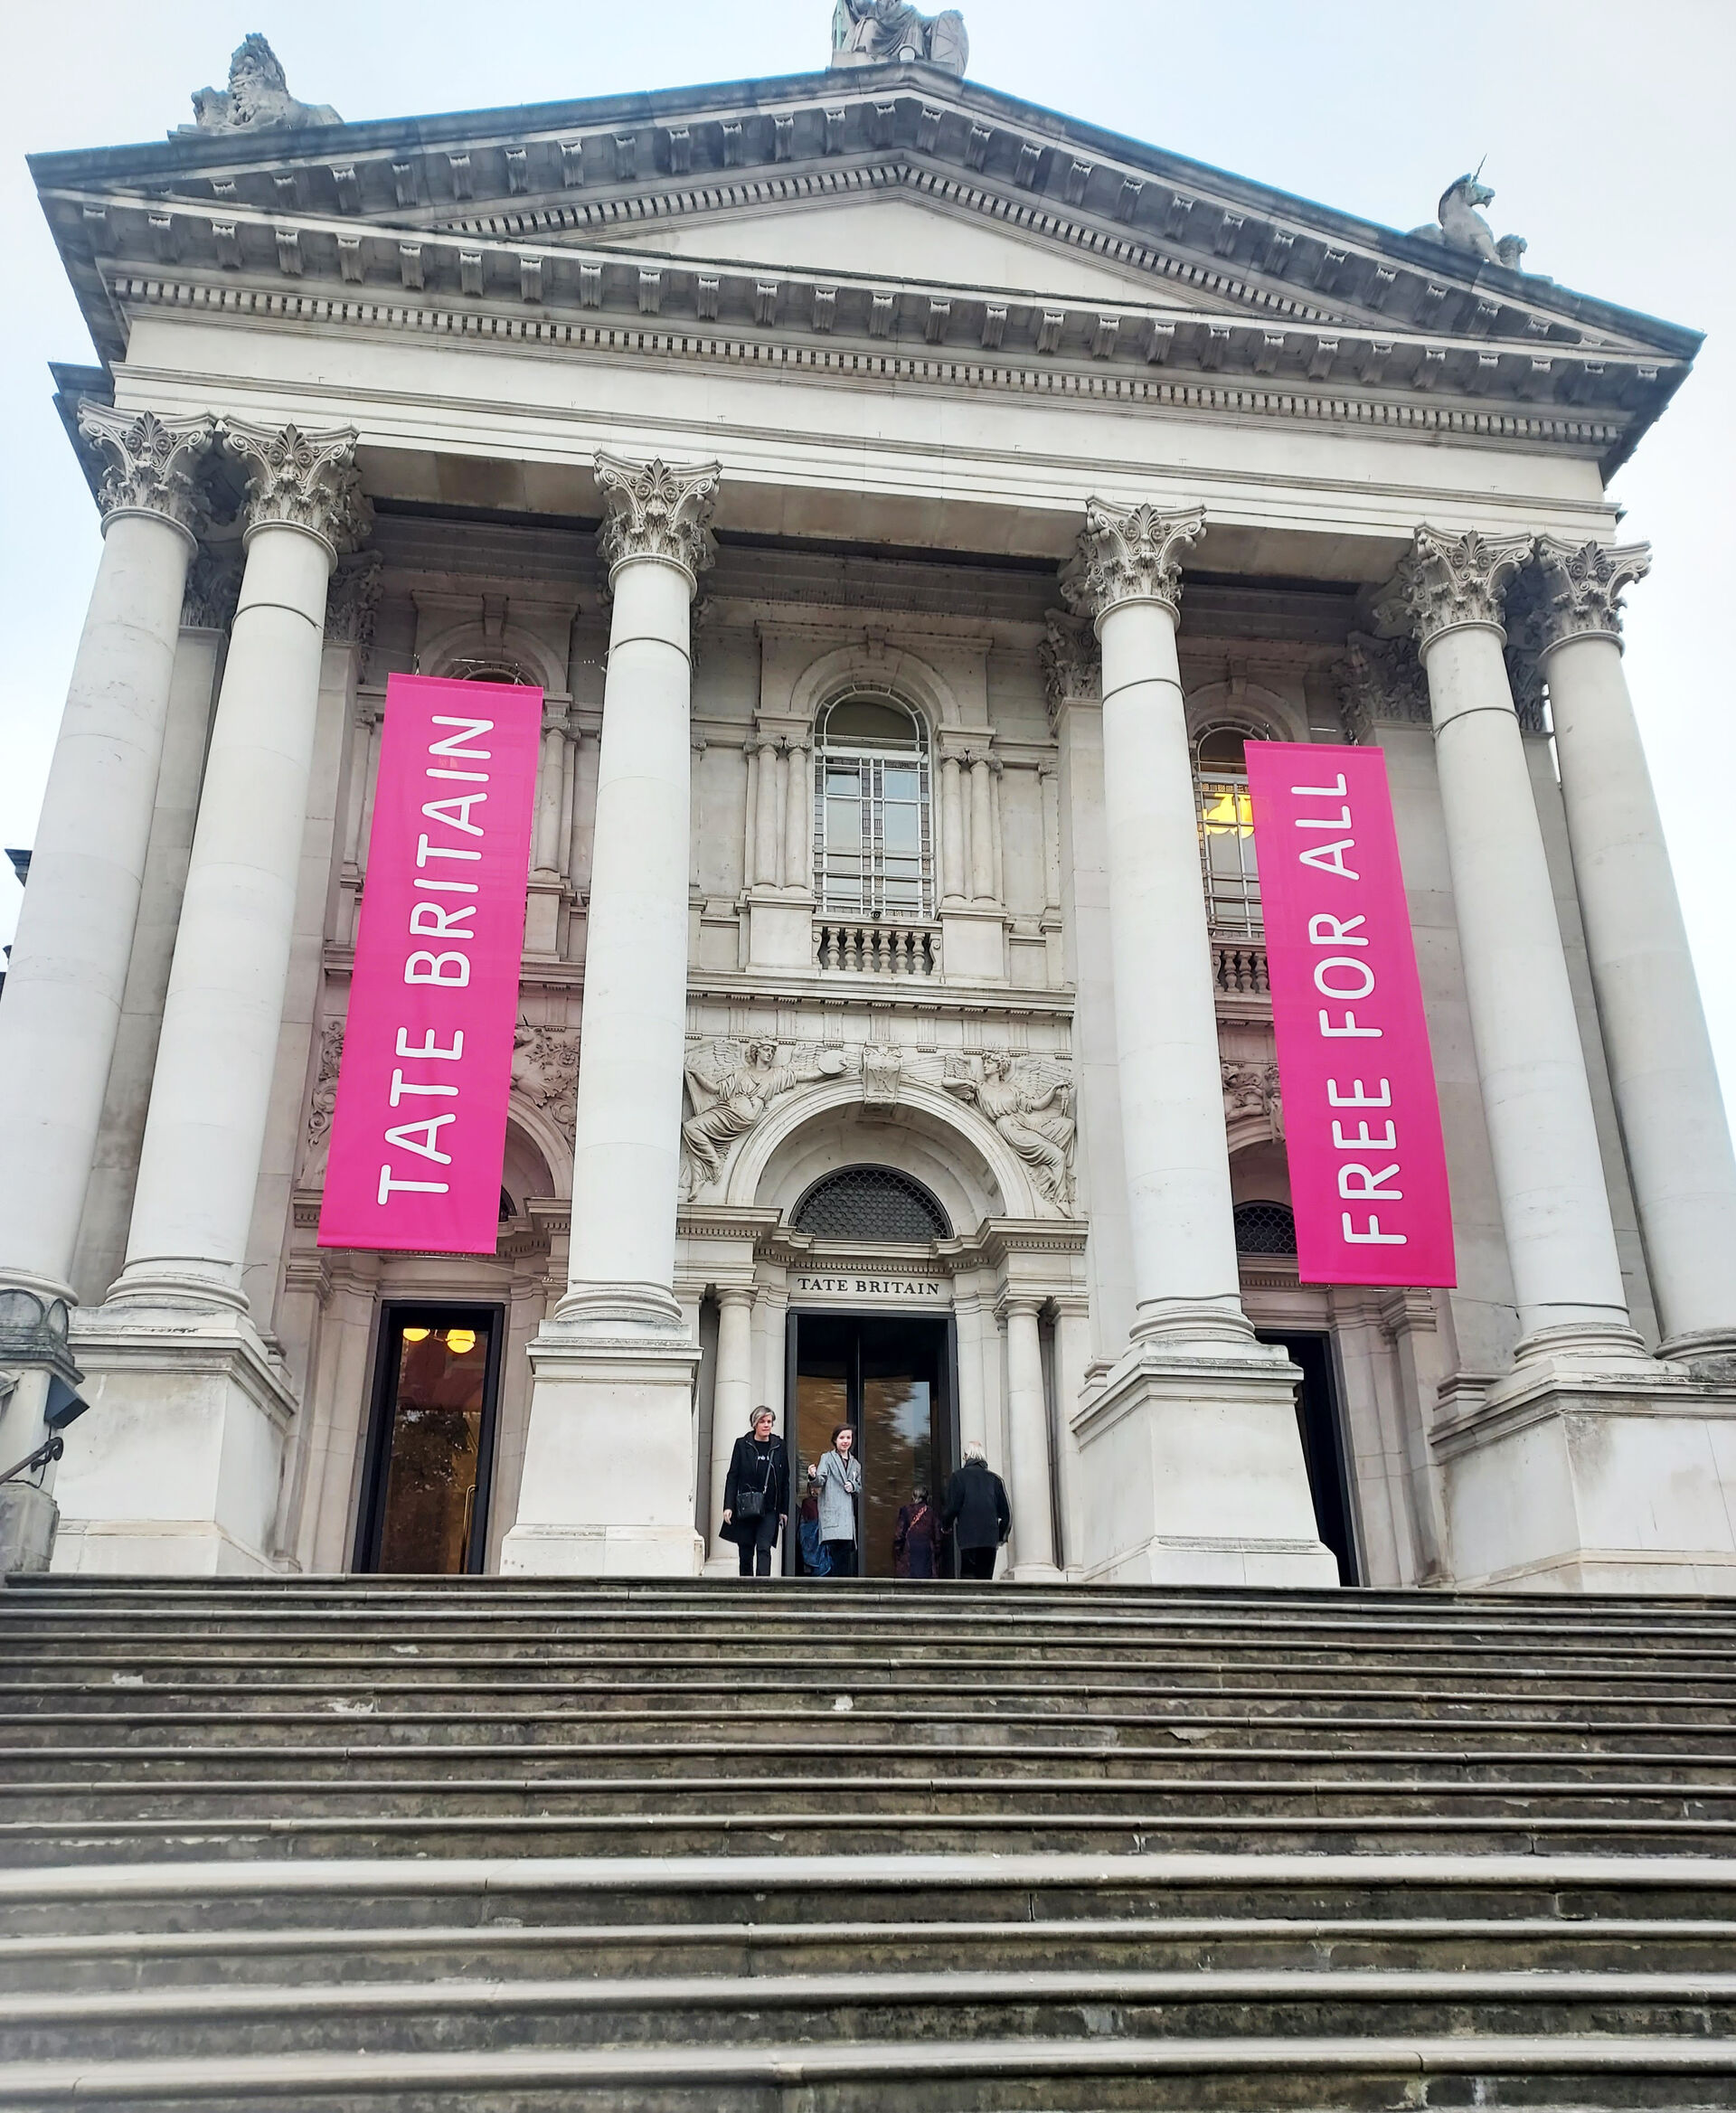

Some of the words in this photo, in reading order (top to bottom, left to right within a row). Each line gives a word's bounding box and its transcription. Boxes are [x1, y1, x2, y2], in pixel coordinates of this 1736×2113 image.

[403, 715, 495, 987] BRITAIN
[1290, 773, 1360, 881] ALL
[1307, 913, 1383, 1037] FOR
[377, 1026, 464, 1205] TATE
[1326, 1078, 1407, 1245] FREE
[797, 1278, 848, 1292] TATE
[854, 1280, 940, 1296] BRITAIN
